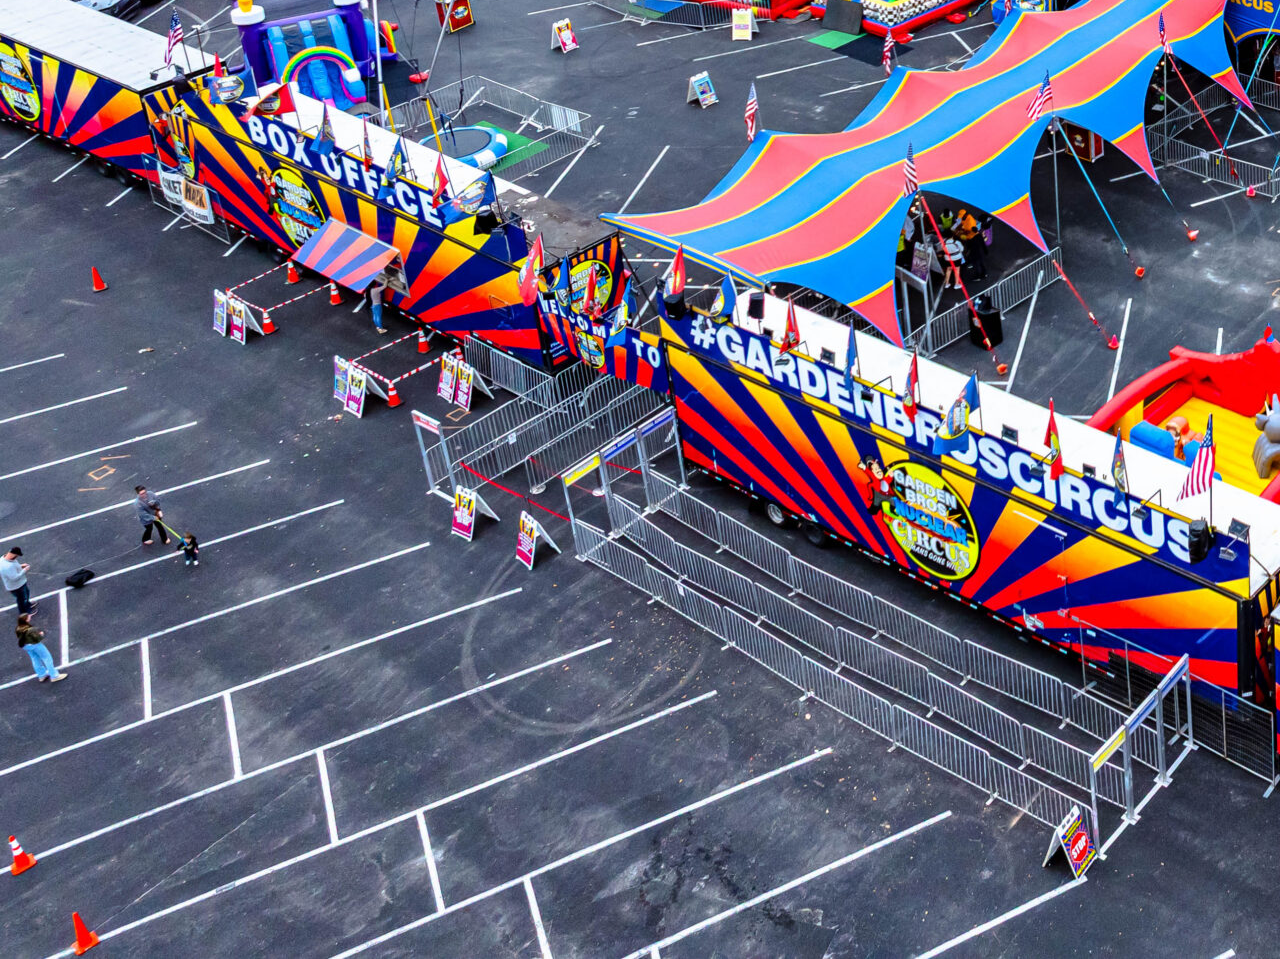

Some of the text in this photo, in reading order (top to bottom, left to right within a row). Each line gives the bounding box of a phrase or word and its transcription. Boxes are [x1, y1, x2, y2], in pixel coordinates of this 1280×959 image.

[247, 114, 313, 168] BOX
[320, 151, 444, 229] OFFCE
[538, 291, 614, 339] WELCOM
[631, 338, 661, 368] TO
[893, 469, 958, 510] GARDEN
[905, 488, 948, 517] BROS
[892, 496, 970, 548] NUCLEAR
[892, 519, 971, 569] CIRCUS
[901, 539, 928, 558] HUMANS
[928, 550, 946, 566] GONE
[1071, 834, 1087, 860] STOP
